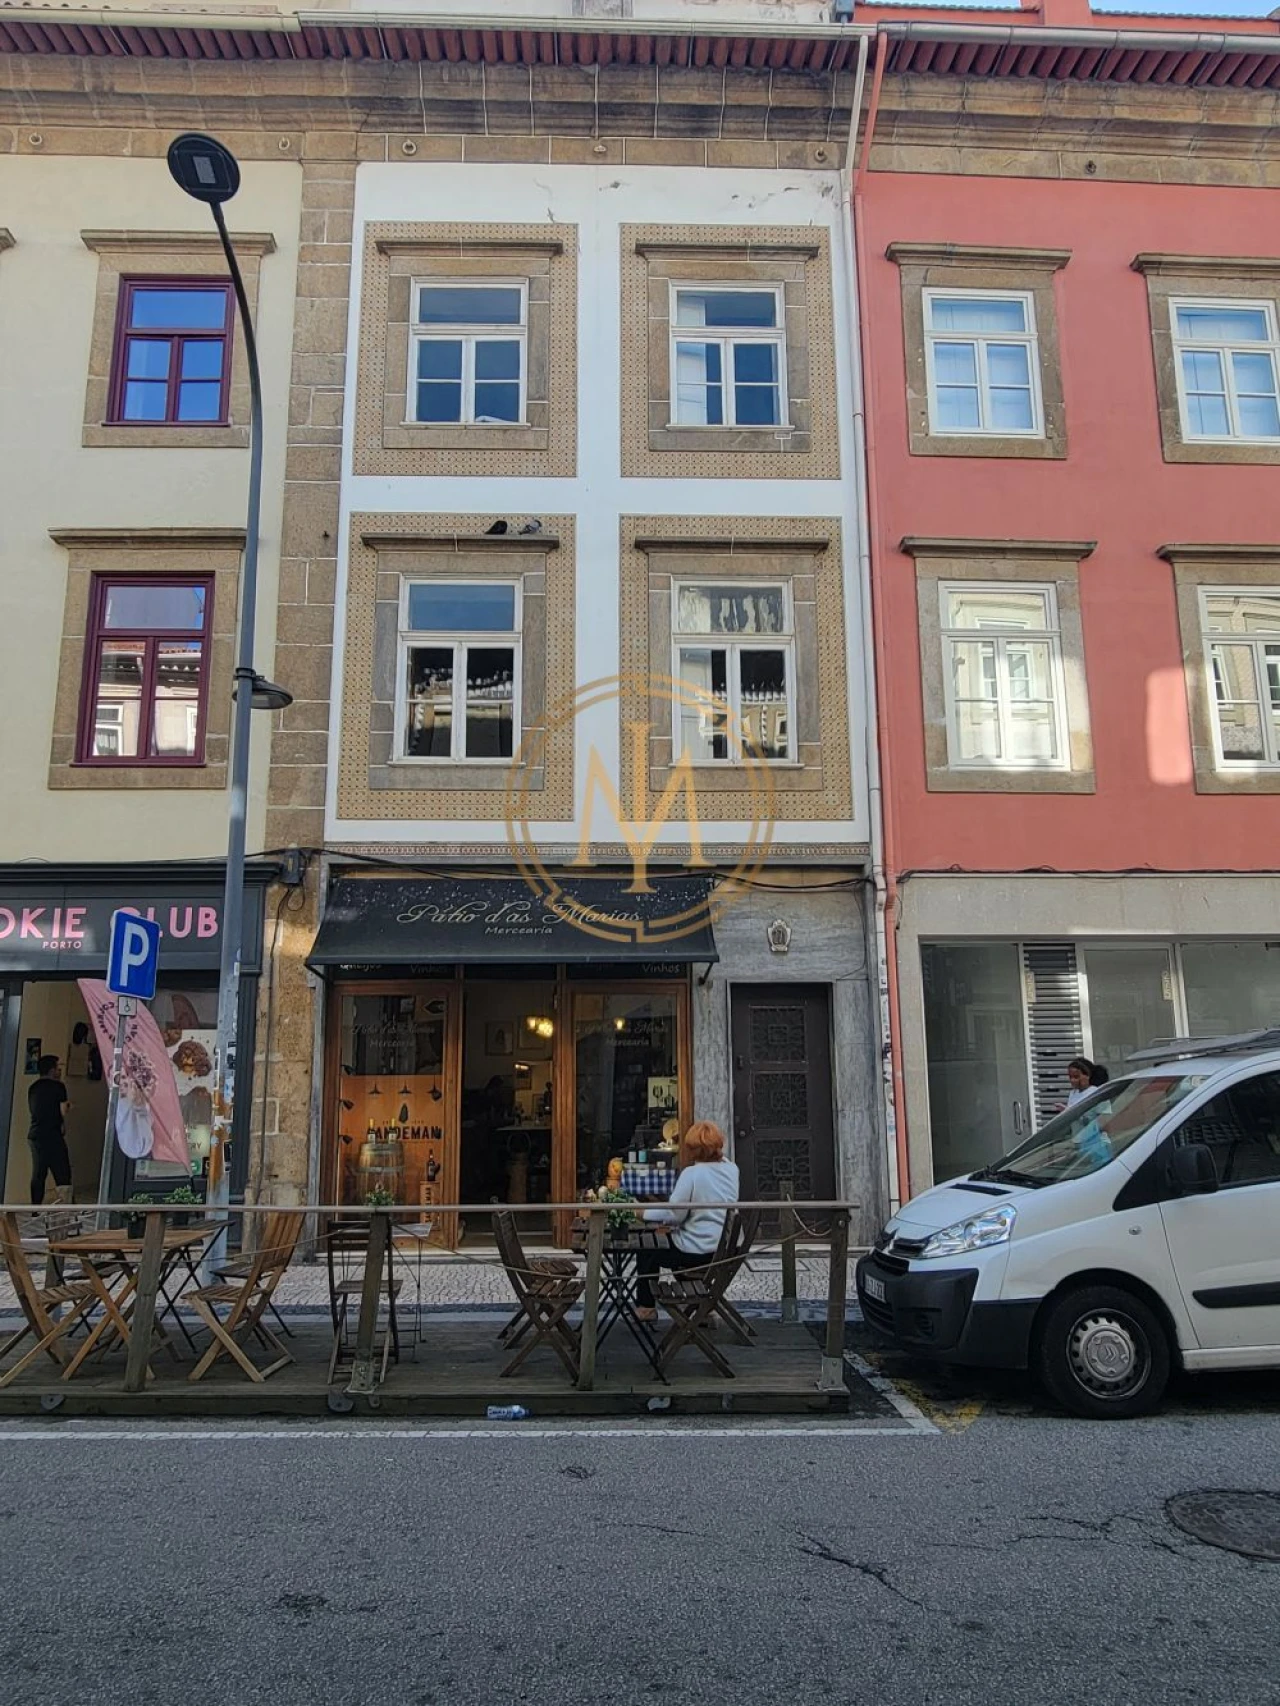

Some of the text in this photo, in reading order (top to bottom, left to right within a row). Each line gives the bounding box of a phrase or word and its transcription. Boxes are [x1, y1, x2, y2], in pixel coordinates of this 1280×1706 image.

[396, 900, 489, 924] Pátio
[542, 903, 642, 926] Marias
[484, 926, 554, 935] Mercearia
[42, 940, 82, 950] PORTO
[119, 921, 150, 987] P
[641, 962, 681, 974] Vinhos
